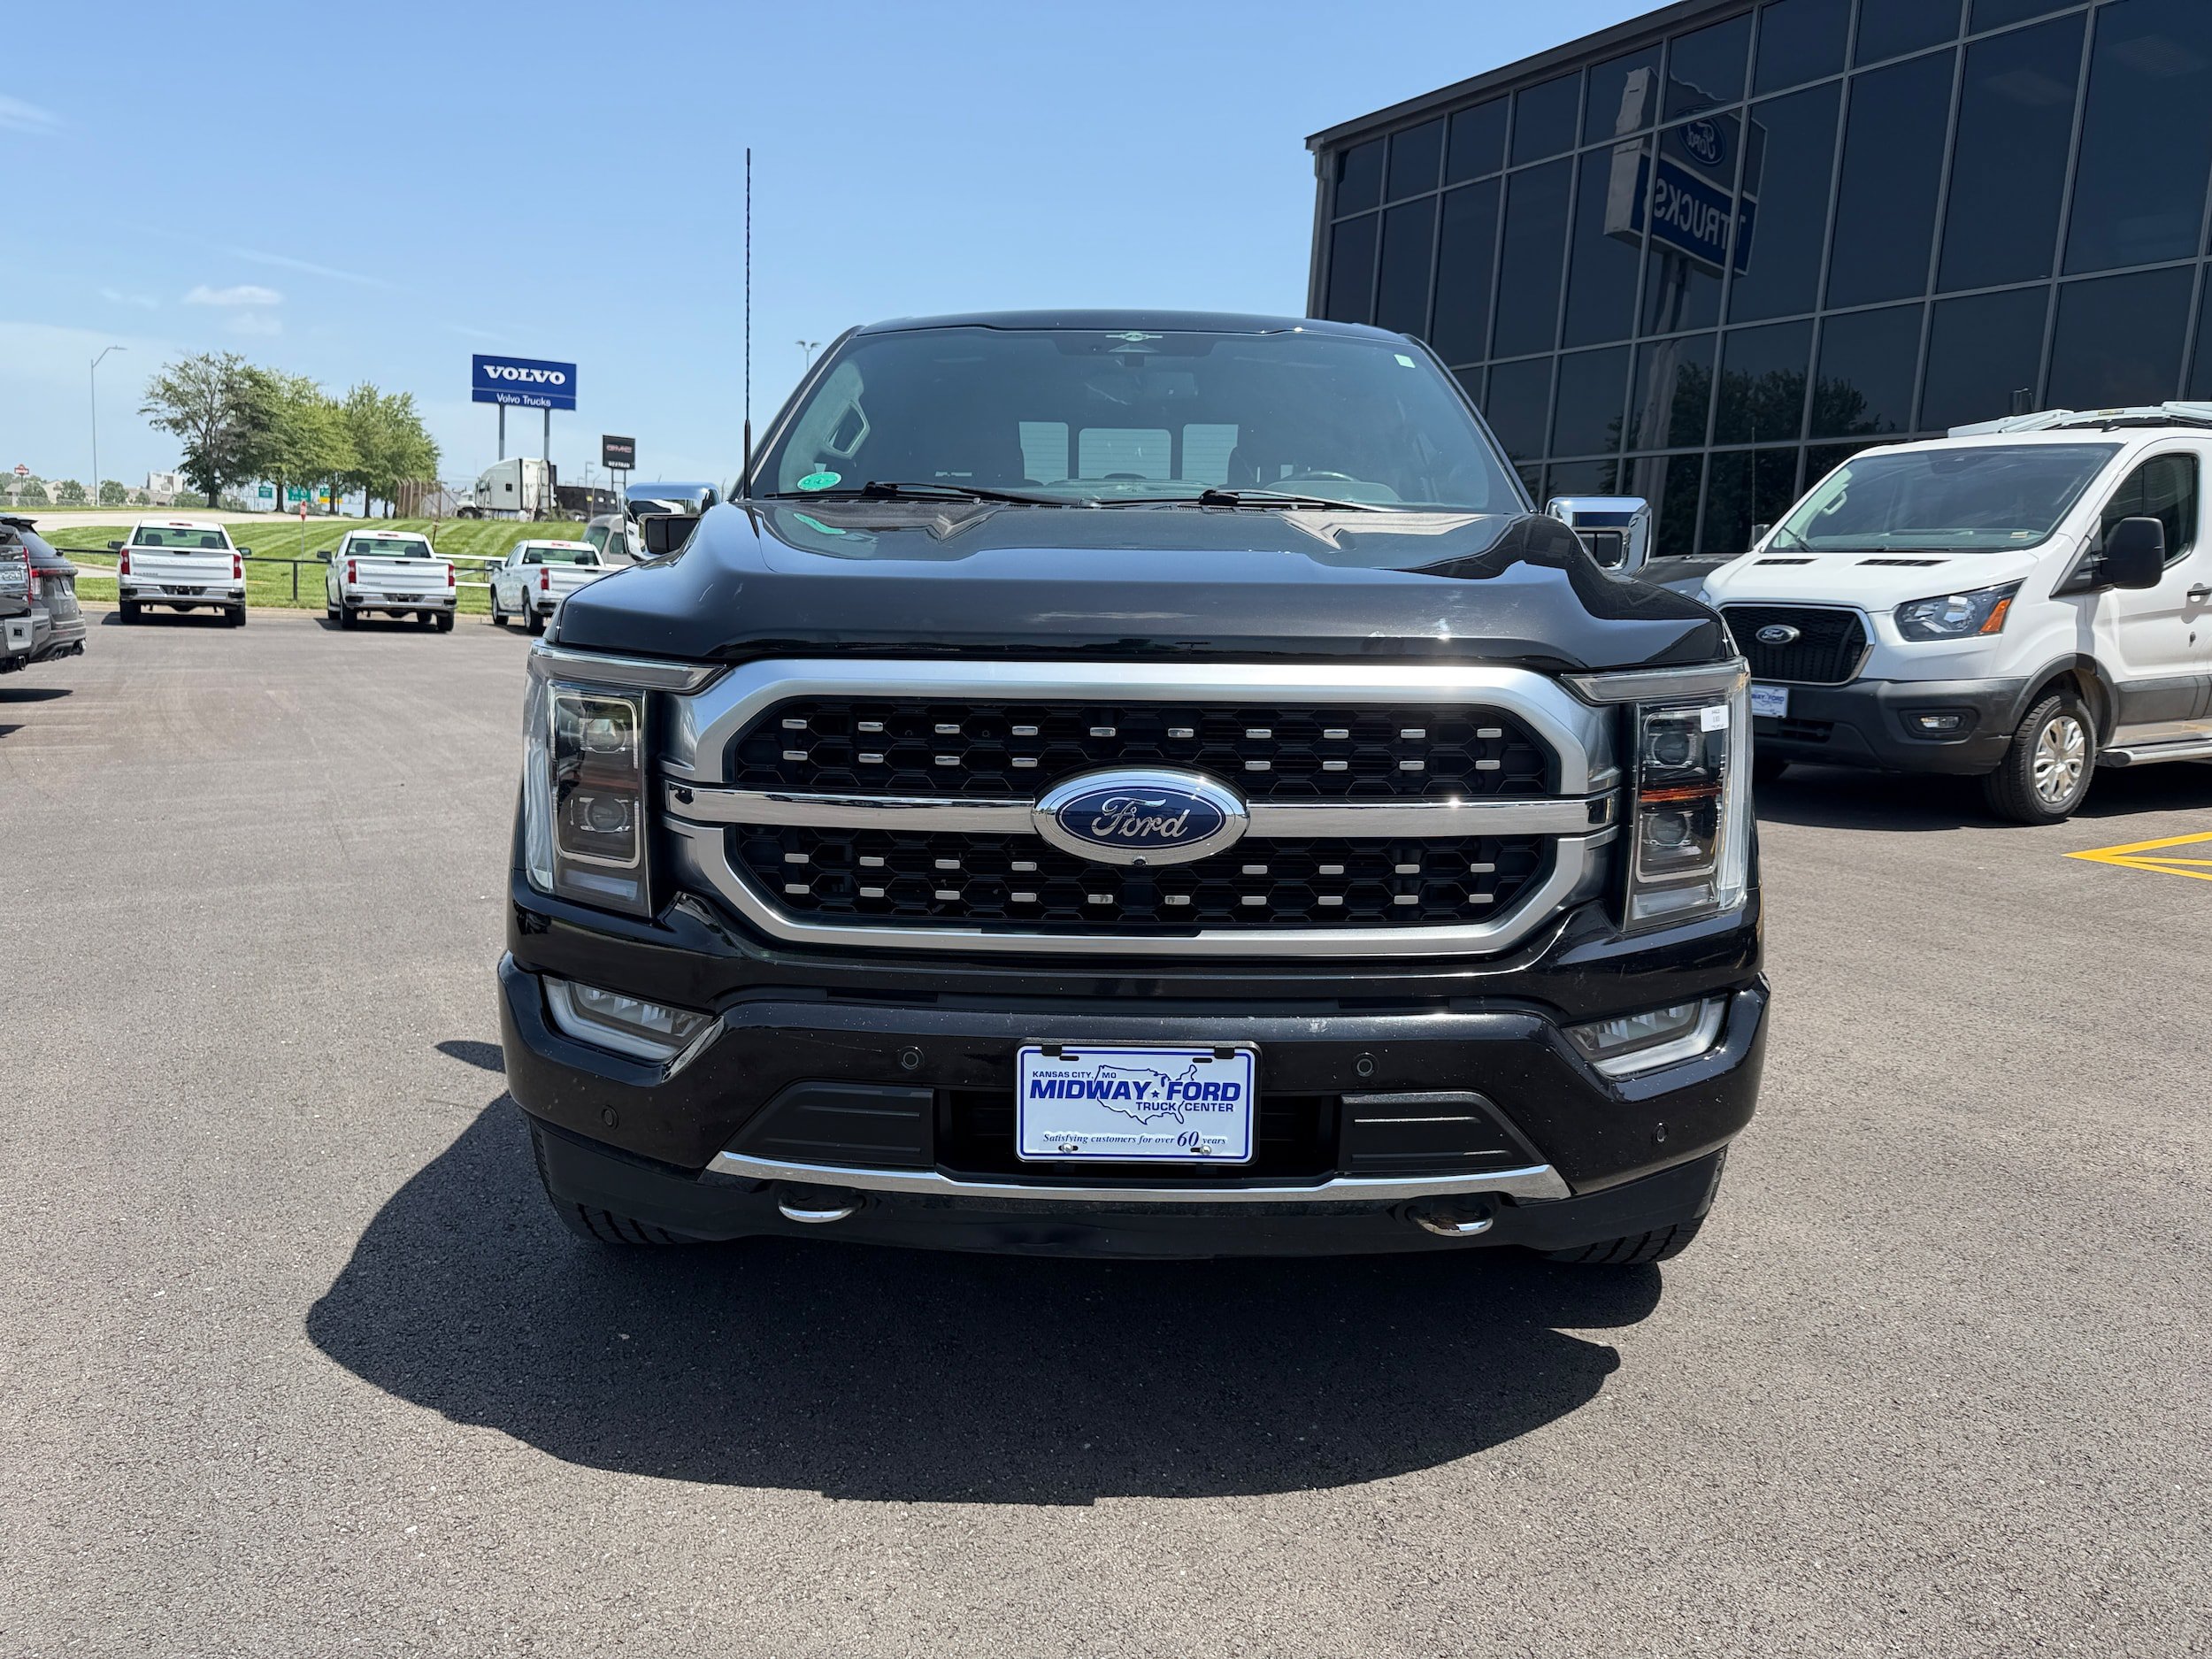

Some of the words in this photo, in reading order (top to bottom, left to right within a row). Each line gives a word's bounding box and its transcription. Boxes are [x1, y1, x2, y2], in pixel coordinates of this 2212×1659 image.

[483, 365, 566, 385] VOLVO
[496, 393, 520, 404] Volvo
[522, 395, 551, 407] Trucks
[606, 444, 632, 453] GMC
[1091, 796, 1191, 838] Ford
[1029, 1079, 1152, 1100] MIDWAY
[1166, 1081, 1240, 1102] FORD
[1136, 1102, 1177, 1111] TRUCK
[1185, 1102, 1234, 1112] CENTER
[1043, 1133, 1088, 1144] Satisfying
[1137, 1134, 1152, 1145] for
[1177, 1131, 1199, 1147] 60
